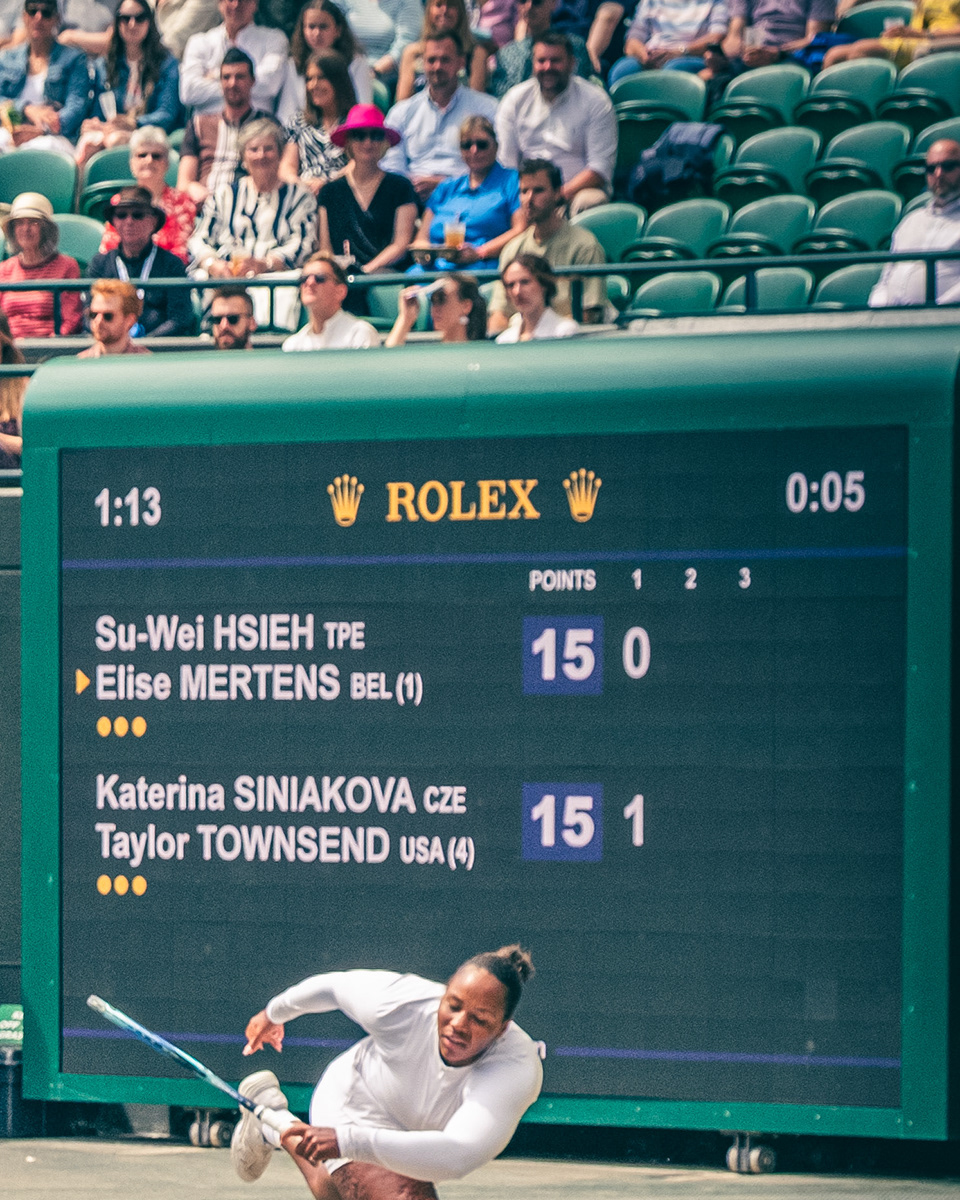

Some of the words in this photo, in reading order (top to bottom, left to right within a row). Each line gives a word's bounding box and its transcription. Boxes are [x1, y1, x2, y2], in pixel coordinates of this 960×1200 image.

[95, 487, 161, 526] 1:13
[386, 479, 540, 521] ROLEX
[787, 471, 865, 513] 0:05
[529, 569, 596, 591] POINTS
[632, 568, 642, 590] 1
[685, 567, 697, 590] 2
[739, 567, 751, 589] 3
[95, 614, 204, 651] Su-Wei
[214, 614, 314, 650] HSIEH
[324, 622, 365, 650] TPE
[531, 628, 595, 680] 15
[622, 626, 651, 679] 0
[96, 664, 171, 700] Elise
[180, 664, 340, 700] MERTENS
[96, 774, 225, 811] Katerina
[233, 776, 416, 813] SINIAKOVA
[424, 786, 466, 814] CZE
[531, 795, 595, 847] 15
[624, 794, 644, 846] 1
[95, 823, 190, 867] Taylor
[197, 825, 389, 863] TOWNSEND
